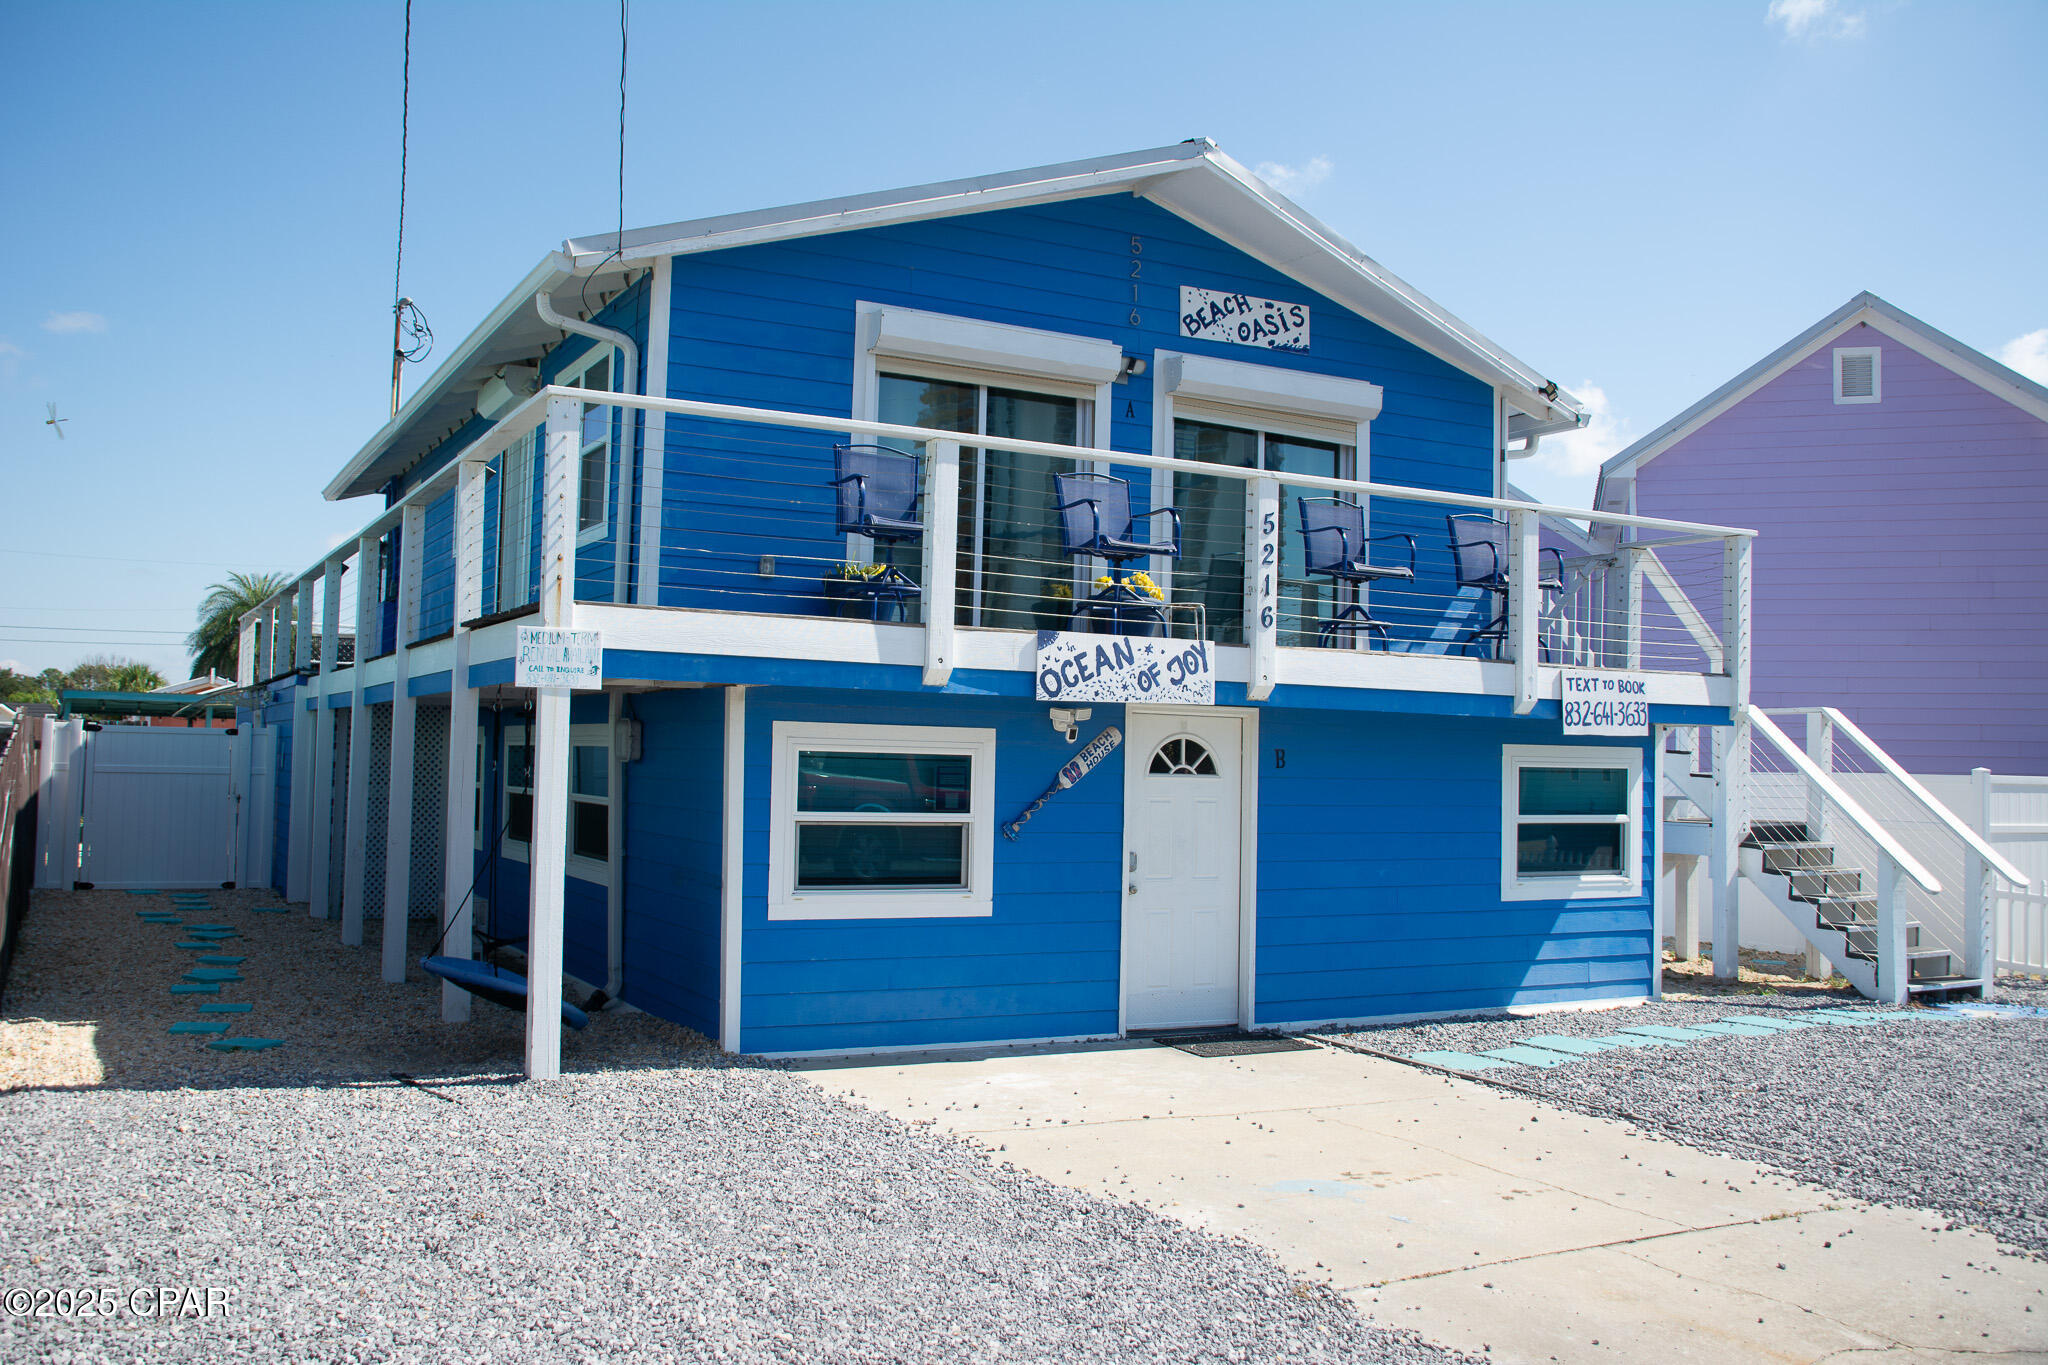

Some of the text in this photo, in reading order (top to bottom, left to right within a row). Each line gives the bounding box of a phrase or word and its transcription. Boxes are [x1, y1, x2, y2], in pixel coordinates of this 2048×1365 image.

[1129, 236, 1143, 326] 5216
[1182, 294, 1253, 336] BEACH
[1125, 399, 1136, 418] A
[1260, 512, 1275, 628] 5216
[1040, 636, 1209, 698] OCEAN OF JOY
[1566, 677, 1599, 692] TEXT
[1618, 679, 1646, 694] BOOK
[1565, 700, 1647, 726] 832-641-3633
[1080, 730, 1113, 762] BEACH
[1086, 740, 1116, 770] HOUSE
[1273, 748, 1286, 769] B
